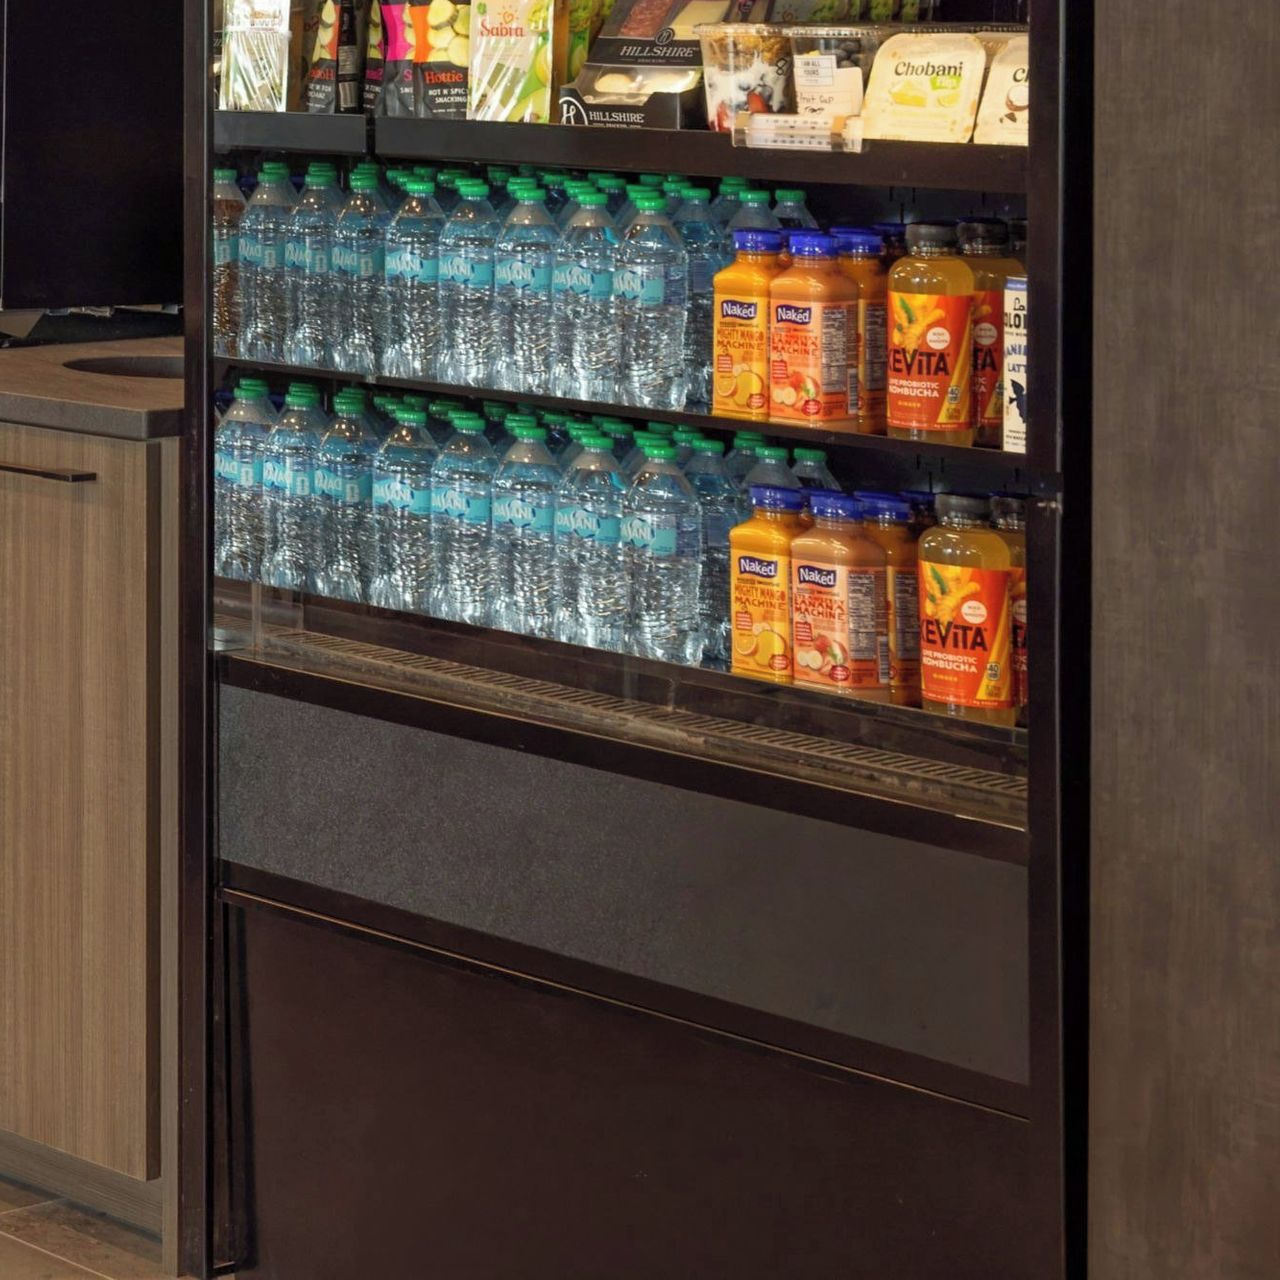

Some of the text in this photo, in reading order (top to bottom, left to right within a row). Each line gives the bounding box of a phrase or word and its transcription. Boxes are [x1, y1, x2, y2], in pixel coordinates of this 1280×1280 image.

[480, 20, 525, 37] Sabra
[619, 46, 694, 58] HILLSHIRE
[425, 70, 463, 84] Hottie
[894, 61, 964, 78] Chobani
[589, 111, 644, 123] HILLSHIRE
[556, 511, 596, 531] DASANI
